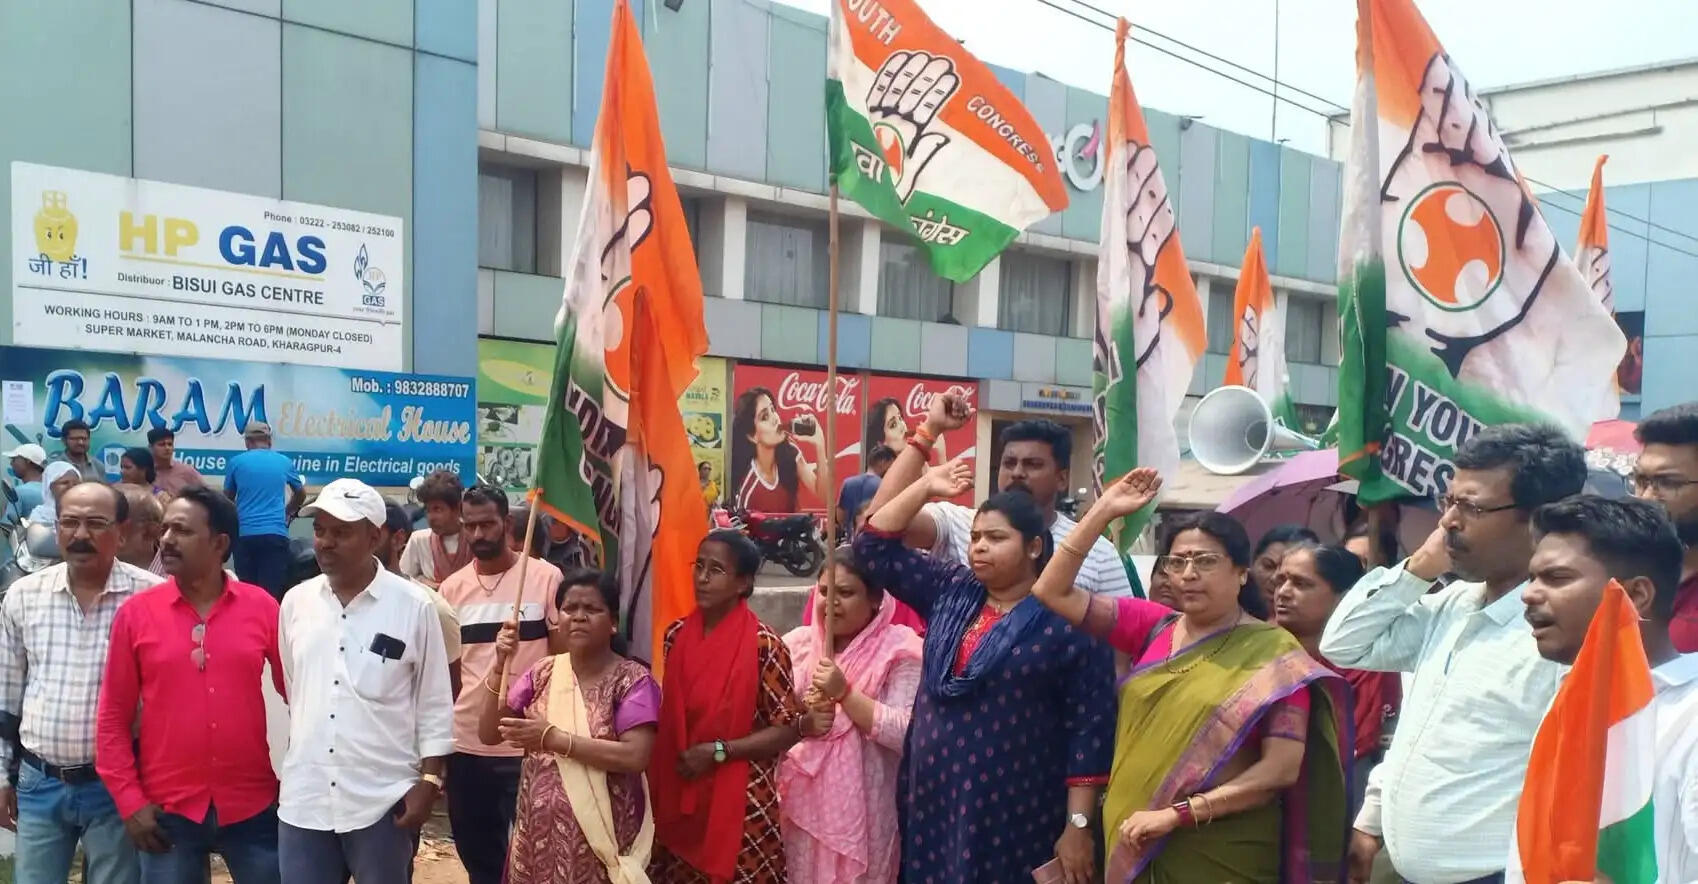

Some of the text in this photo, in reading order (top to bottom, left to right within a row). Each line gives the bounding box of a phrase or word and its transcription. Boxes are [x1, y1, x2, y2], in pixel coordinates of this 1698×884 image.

[847, 0, 902, 45] OUTH
[967, 96, 1044, 172] CONGRESS
[850, 141, 885, 184] वा
[264, 210, 292, 223] Phone
[299, 215, 325, 228] 03222
[119, 210, 327, 274] HP GAS
[28, 252, 53, 275] जी
[117, 272, 165, 286] Distribuor
[172, 275, 217, 294] BISUI
[222, 281, 256, 298] GAS
[261, 285, 324, 305] CENTRE
[44, 304, 101, 319] WORKING
[104, 310, 143, 322] HOURS
[152, 314, 175, 325] 9AM
[178, 316, 192, 327] TO
[195, 318, 200, 327] 1
[224, 321, 245, 331] 2PM
[248, 322, 261, 333] TO
[264, 324, 283, 334] 6PM
[286, 327, 330, 339] (MONDAY
[332, 332, 373, 345] CLOSED)
[85, 324, 124, 336] SUPER
[177, 331, 235, 345] MALANCHA
[272, 340, 342, 354] KHARAGPUR-4
[44, 369, 271, 439] BARAM
[351, 376, 383, 394] Mob.
[394, 379, 469, 399] 9832888707
[778, 372, 860, 414] Coca-Cla
[277, 402, 472, 445] Electrical House
[1406, 380, 1488, 455] YOU
[172, 451, 226, 470] House
[325, 456, 340, 472] in
[344, 456, 413, 474] Electrical
[417, 459, 460, 477] goods
